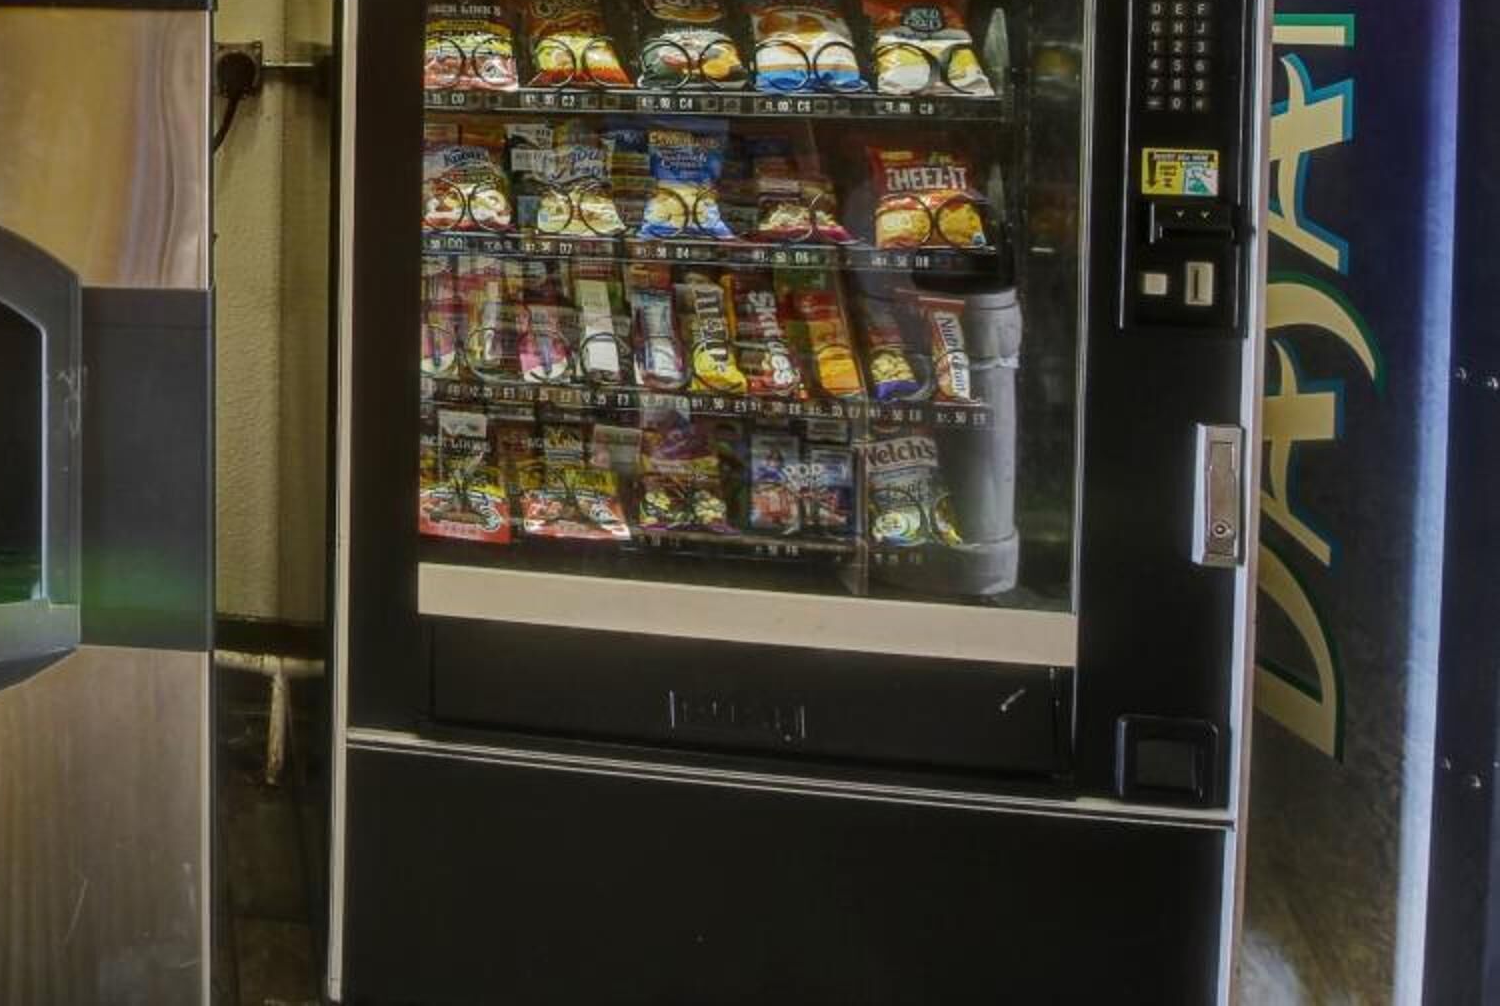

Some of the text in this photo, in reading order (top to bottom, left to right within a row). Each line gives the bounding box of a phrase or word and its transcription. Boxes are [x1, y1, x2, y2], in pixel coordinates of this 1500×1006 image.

[1175, 3, 1183, 14] E
[1197, 3, 1205, 14] F
[1174, 22, 1183, 33] H
[1174, 41, 1182, 52] 2
